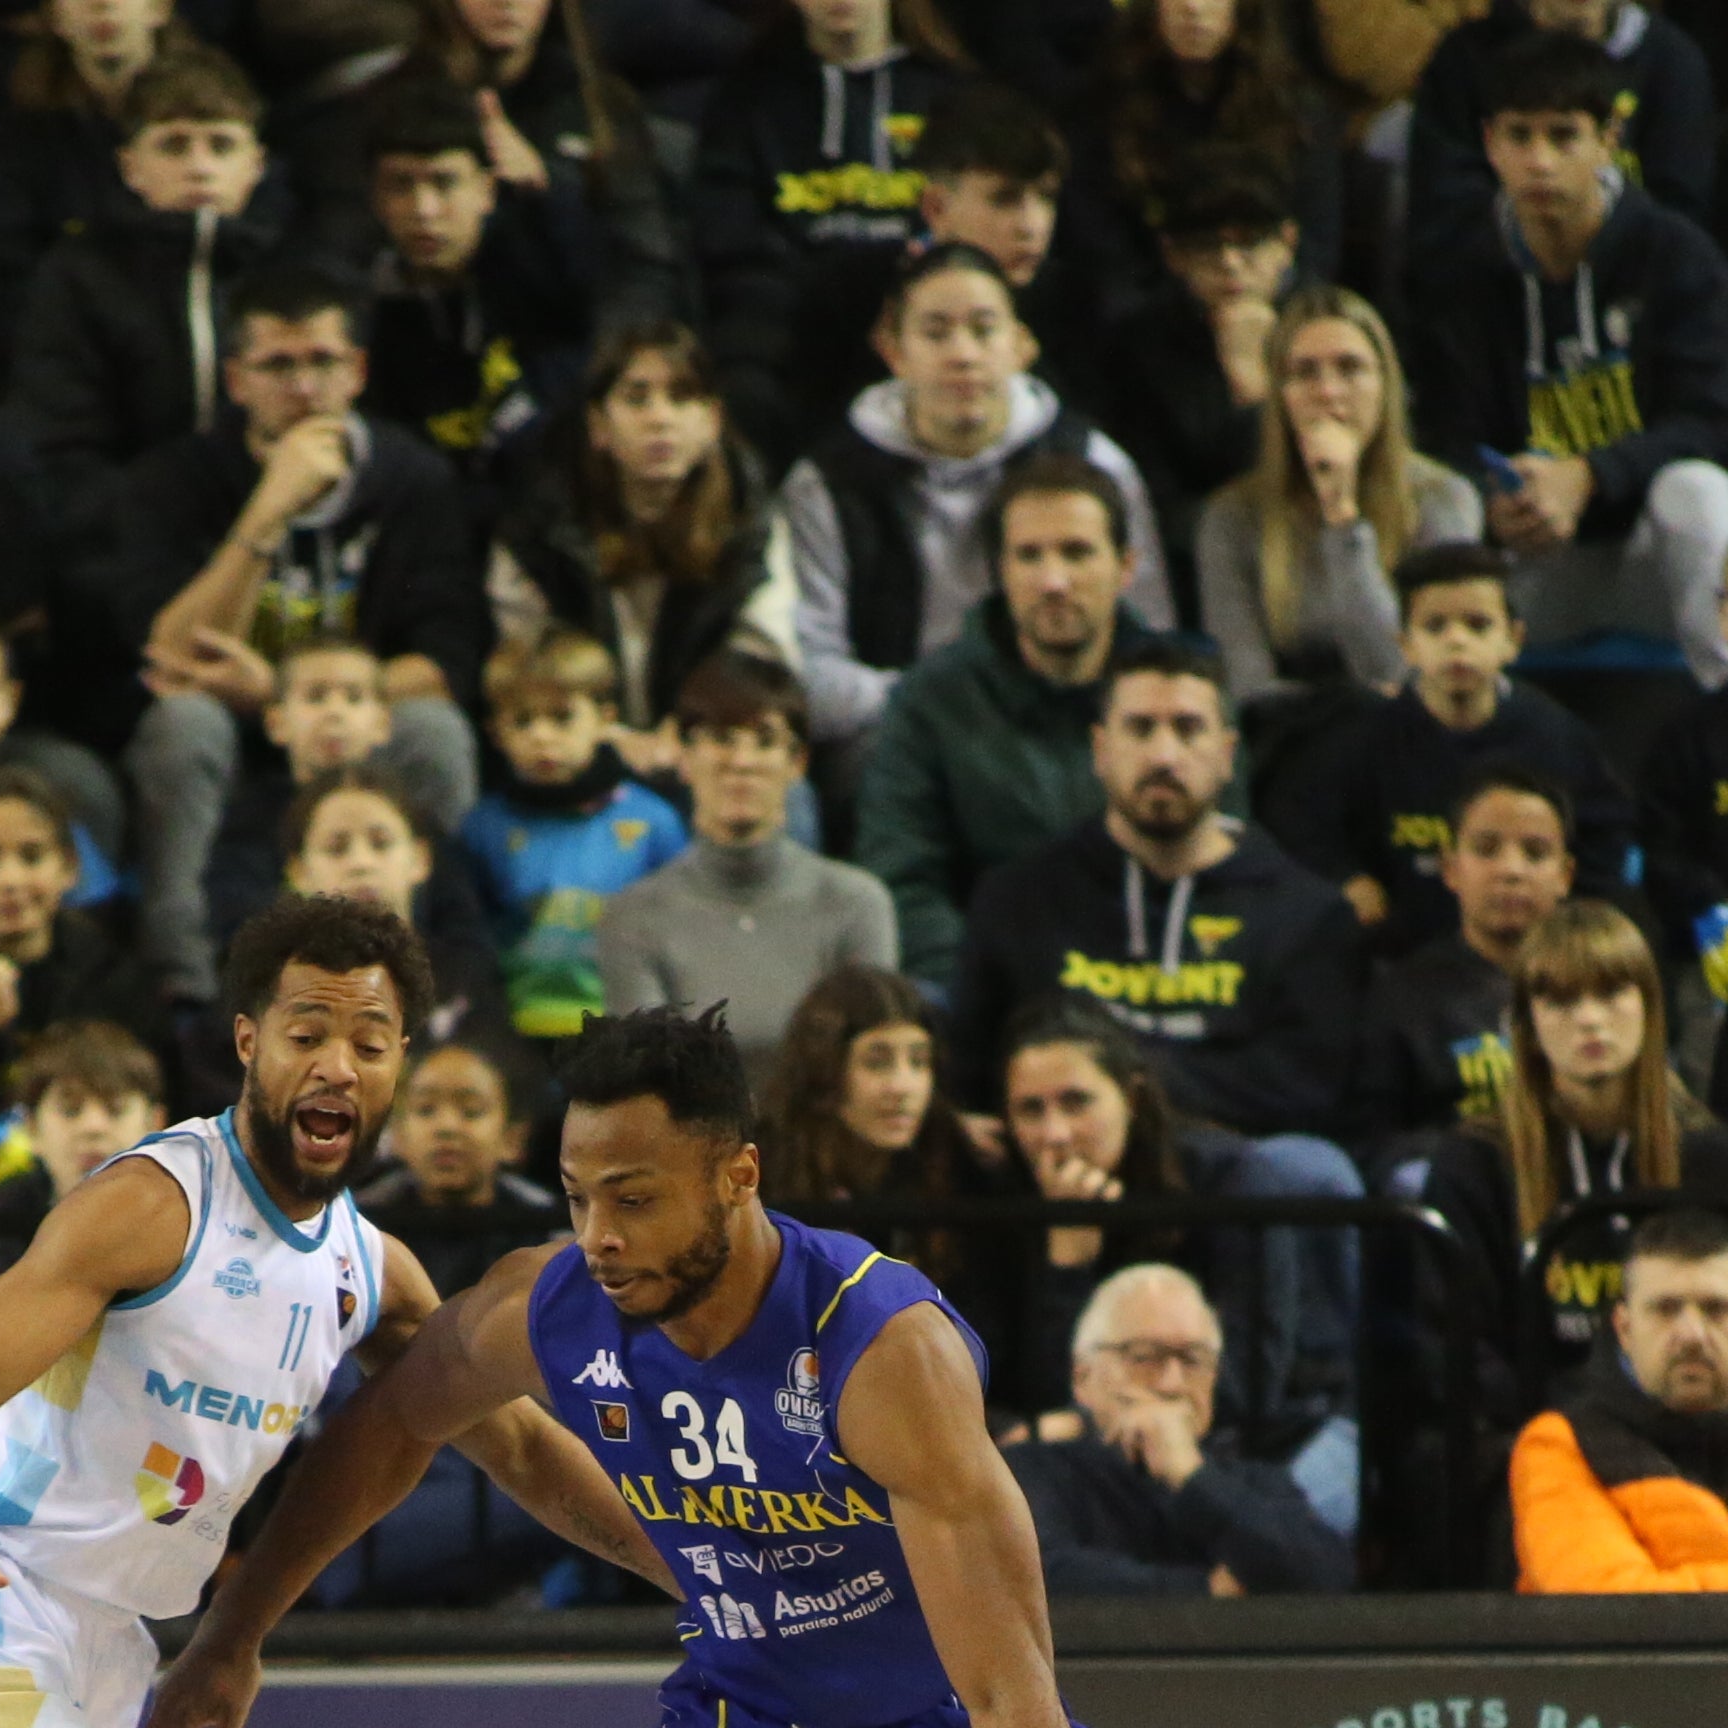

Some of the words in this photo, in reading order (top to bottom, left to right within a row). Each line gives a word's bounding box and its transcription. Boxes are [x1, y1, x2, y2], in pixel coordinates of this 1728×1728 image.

[1059, 950, 1245, 1006] JOVENT
[278, 1302, 314, 1374] 11
[661, 1390, 758, 1483] 34
[621, 1472, 887, 1534] ALMERKA
[842, 1587, 895, 1623] natural
